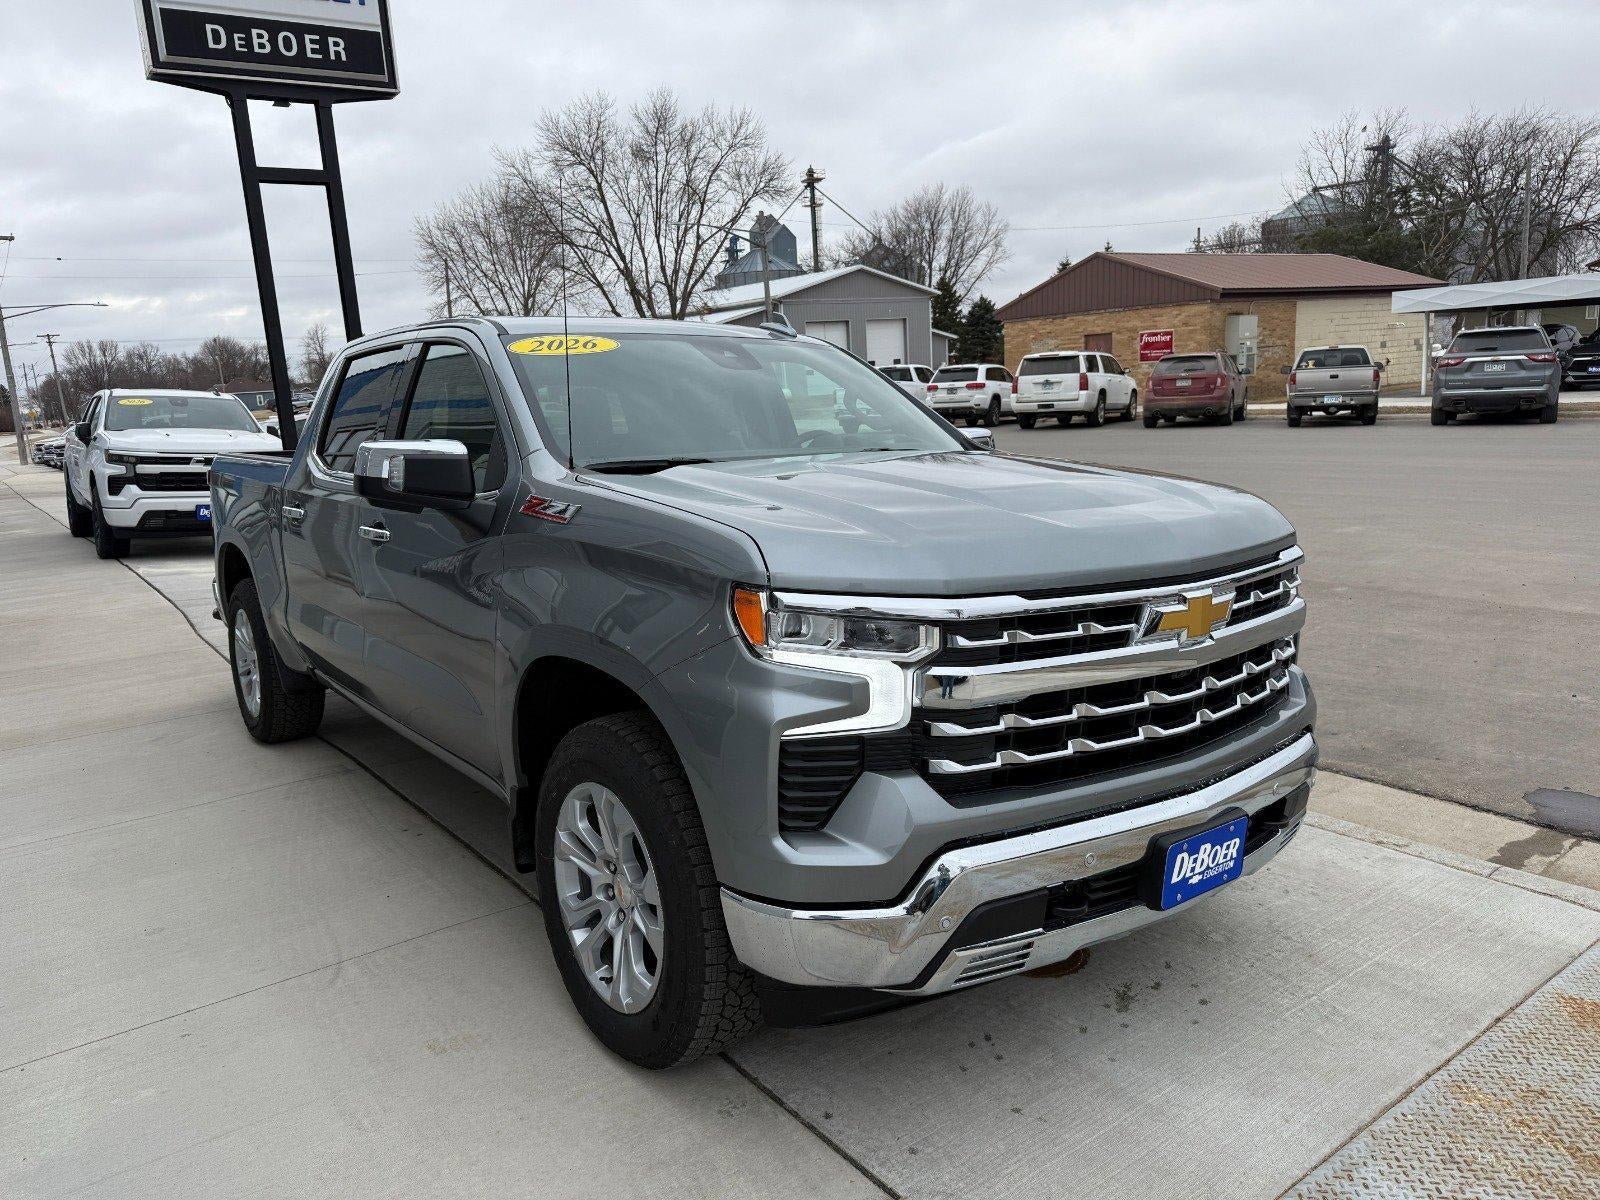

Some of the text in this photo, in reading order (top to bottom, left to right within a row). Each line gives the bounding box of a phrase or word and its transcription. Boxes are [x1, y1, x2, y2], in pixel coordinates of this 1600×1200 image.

[527, 338, 598, 352] 2026
[1140, 333, 1172, 345] frontier
[519, 494, 582, 524] Z71
[1203, 859, 1235, 879] EDGERTON
